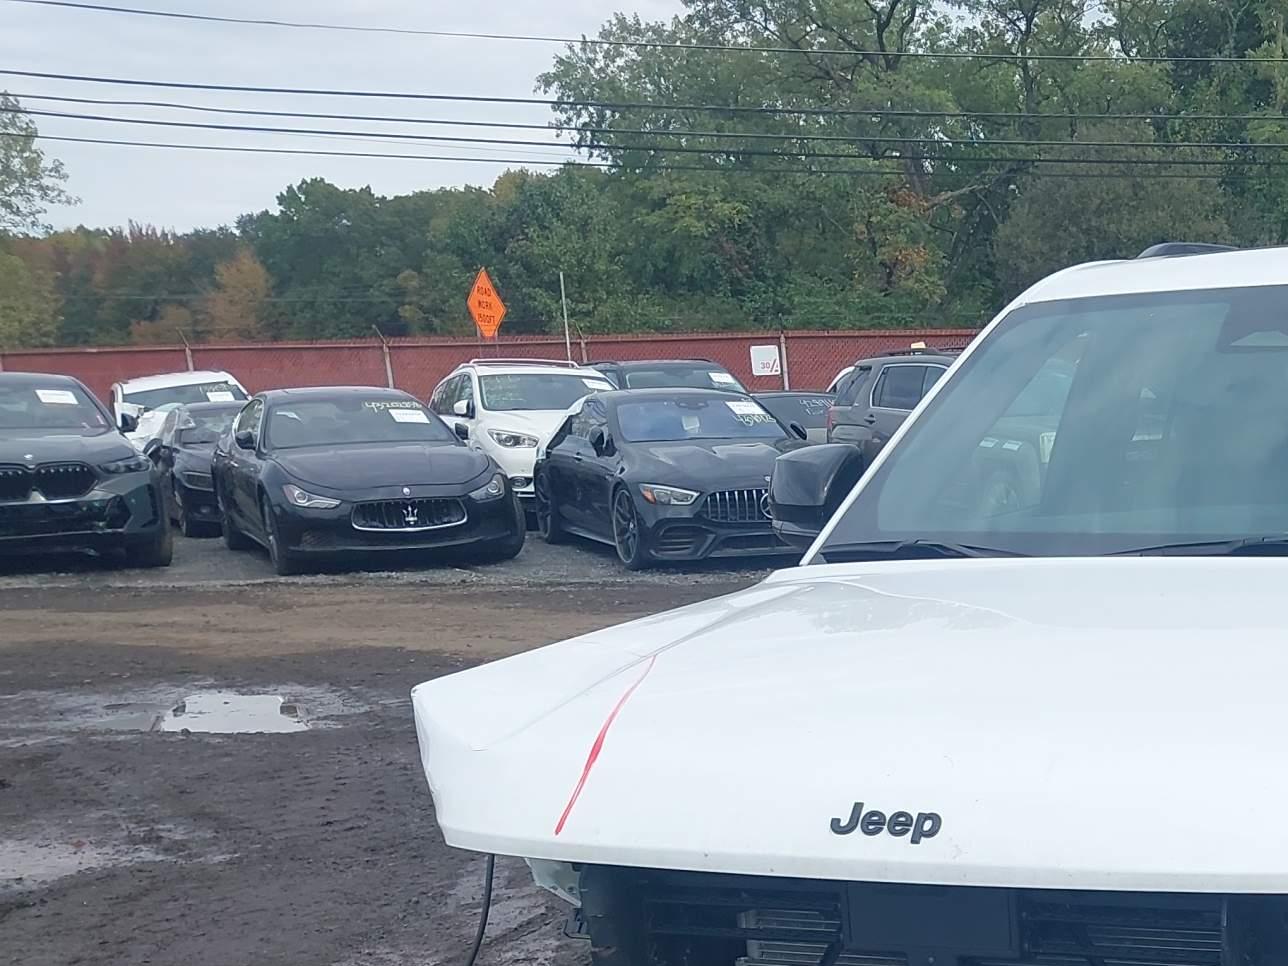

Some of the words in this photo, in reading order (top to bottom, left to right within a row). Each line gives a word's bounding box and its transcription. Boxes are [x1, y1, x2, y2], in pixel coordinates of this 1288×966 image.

[476, 285, 492, 297] ROAD
[477, 300, 493, 311] WORK
[830, 802, 942, 844] Jeep
